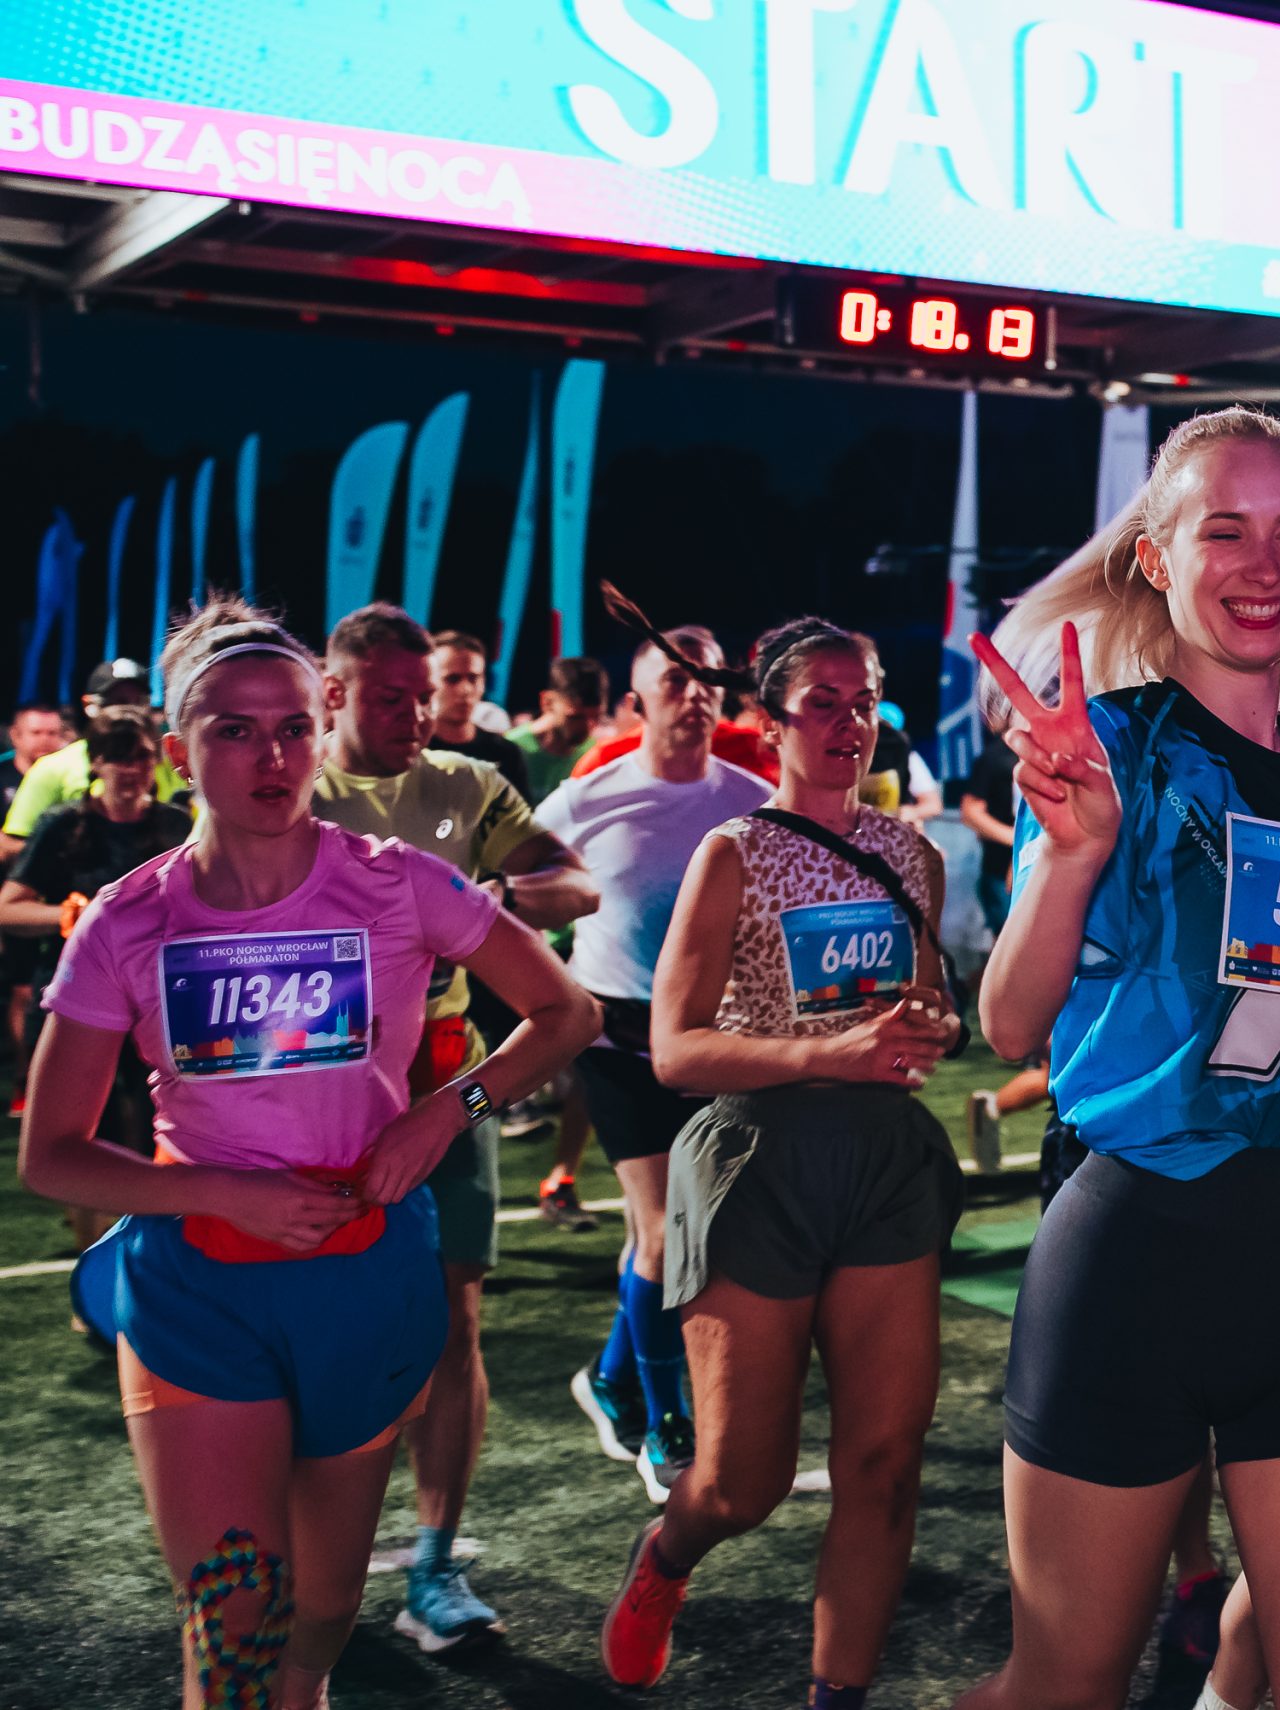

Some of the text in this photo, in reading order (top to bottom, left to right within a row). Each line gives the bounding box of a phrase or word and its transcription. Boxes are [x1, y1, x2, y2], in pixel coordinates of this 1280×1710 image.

[563, 0, 1257, 239] START
[0, 96, 534, 228] BUDZĄSIĘNOCĄ
[1165, 786, 1196, 828] NOCNY
[229, 952, 300, 966] PÓŁMARATON
[236, 944, 274, 956] NOCNY
[275, 941, 329, 953] WROCŁAW
[821, 930, 894, 974] 6402
[210, 970, 333, 1025] 11343
